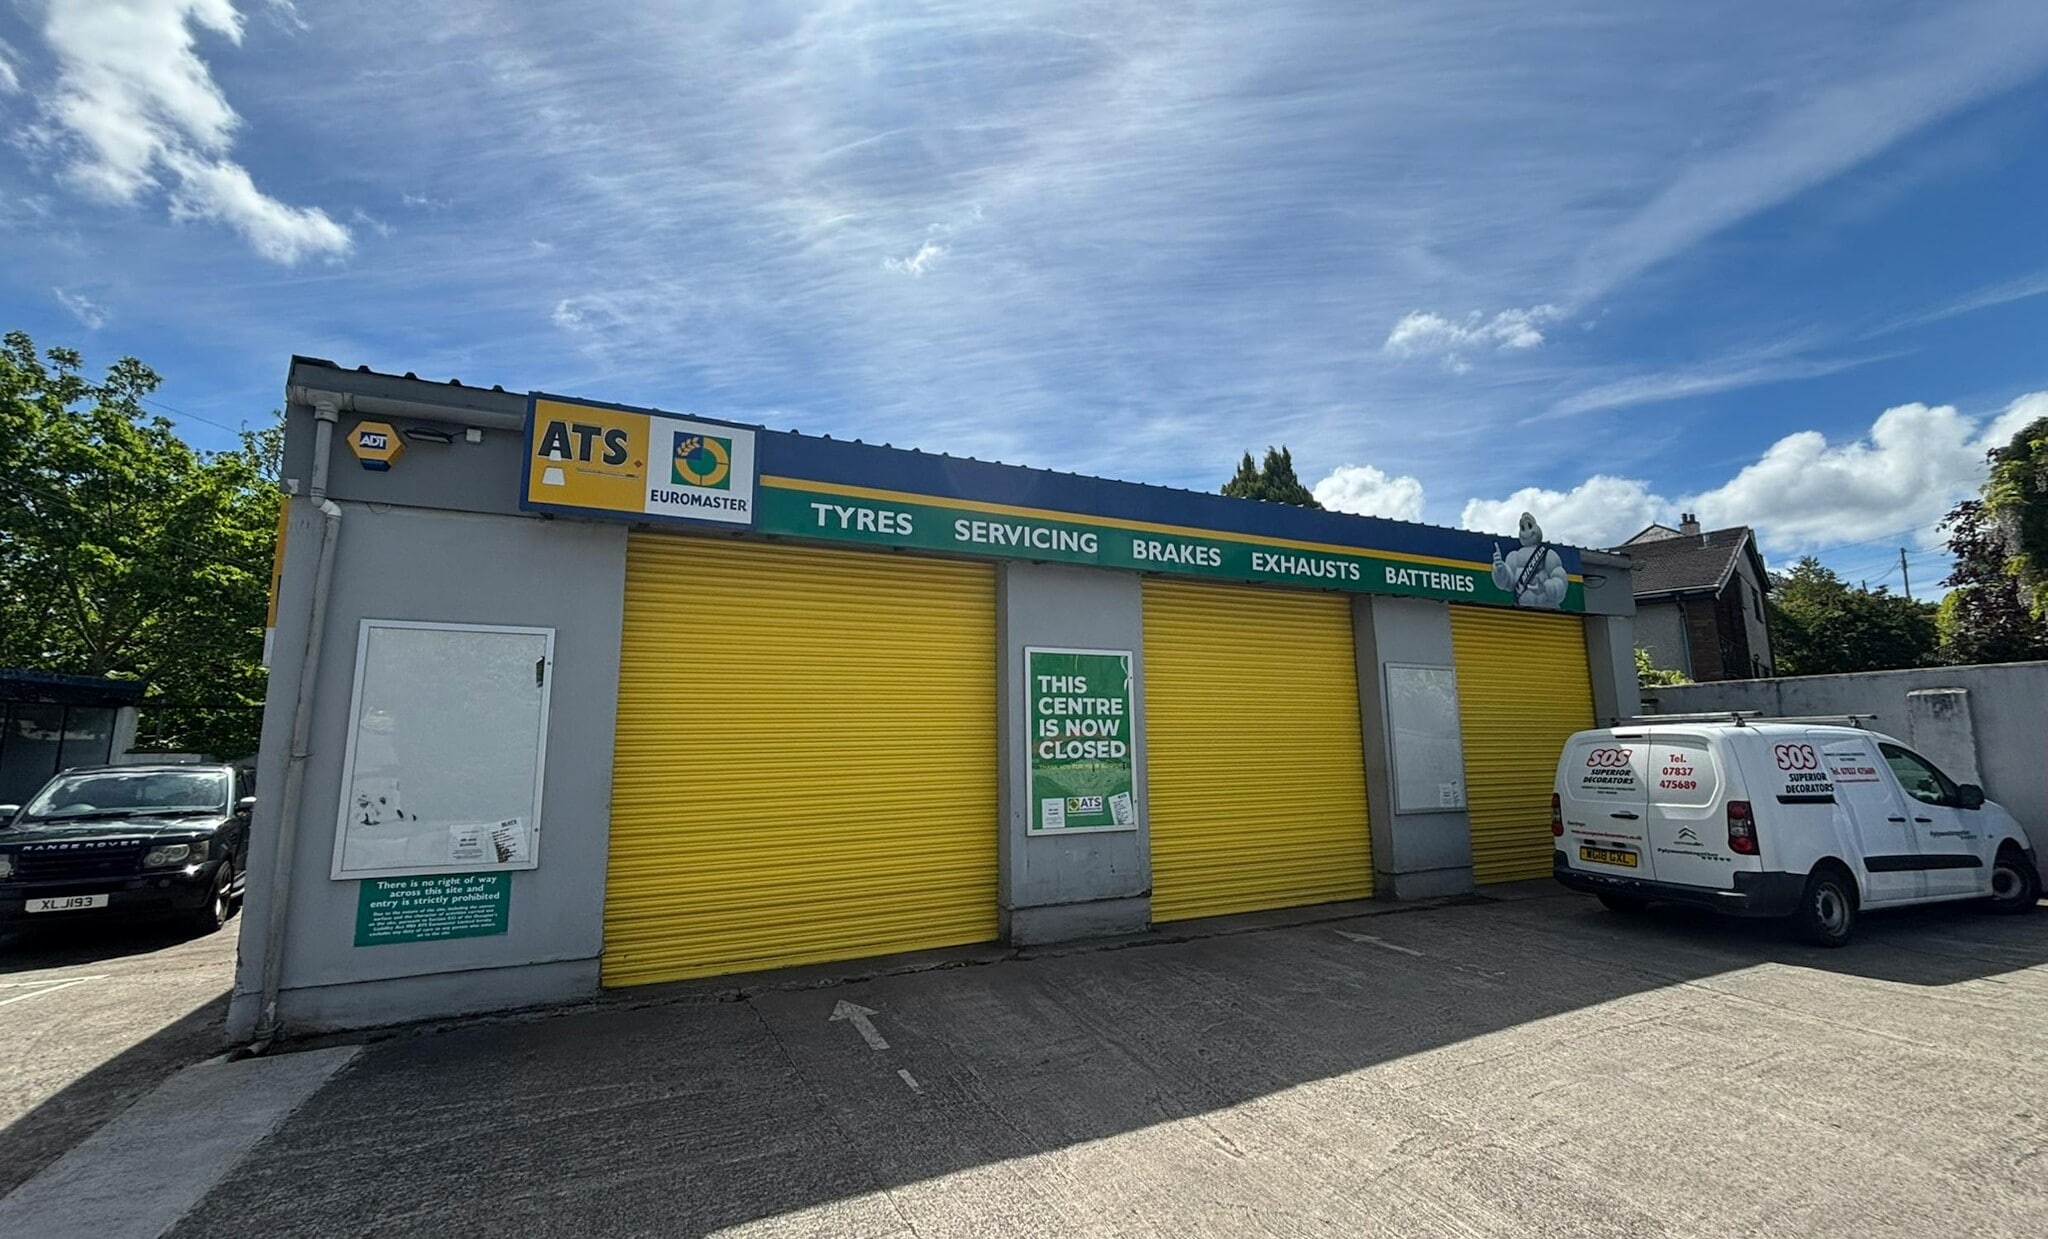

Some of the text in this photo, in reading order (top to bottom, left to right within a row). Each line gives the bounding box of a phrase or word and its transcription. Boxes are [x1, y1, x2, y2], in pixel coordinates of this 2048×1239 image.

[359, 434, 387, 448] ADT
[537, 420, 628, 466] ATS
[650, 489, 748, 512] EUROMASTER
[811, 502, 1475, 593] TYRES SERVICING BRAKES EXHAUSTS BATTERIES
[1037, 675, 1088, 694] THIS
[1038, 697, 1124, 716] CENTRE
[1039, 719, 1120, 737] IS NOW
[1039, 740, 1127, 760] CLOSED
[1586, 749, 1633, 768] SOS
[1669, 754, 1686, 763] Tel.
[1775, 744, 1817, 770] SOS
[1591, 769, 1632, 777] SUPERIOR
[1662, 767, 1694, 776] 07837
[1789, 772, 1827, 782] SUPERIOR
[1583, 777, 1634, 785] DECORATORS
[1659, 780, 1696, 790] 475689
[1785, 783, 1834, 794] DECORATORS
[1080, 797, 1102, 808] ATS
[22, 840, 141, 851] RANGE ROVER
[377, 881, 407, 890] There
[438, 878, 460, 886] right
[390, 889, 421, 897] across
[425, 887, 442, 895] this
[446, 886, 463, 894] site
[370, 899, 398, 908] entry
[414, 896, 448, 905] strictly
[452, 892, 500, 903] prohibited
